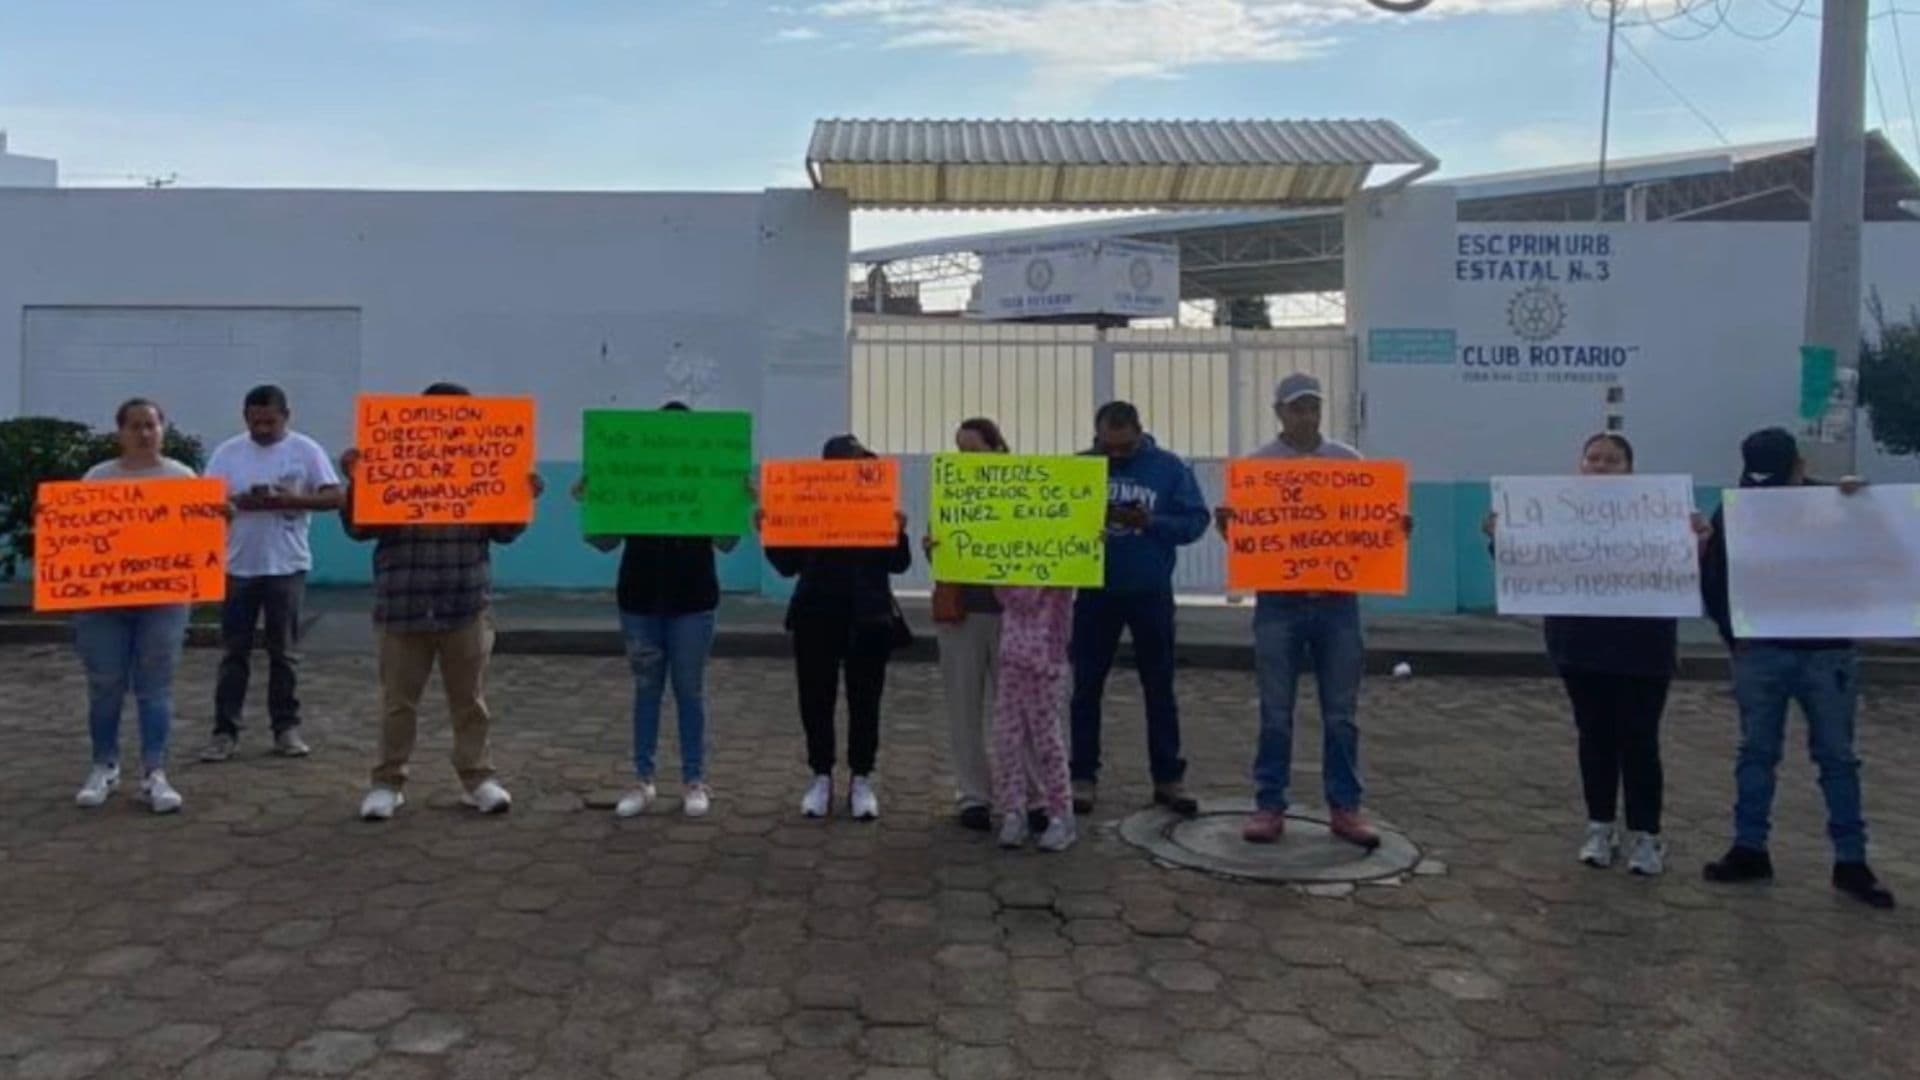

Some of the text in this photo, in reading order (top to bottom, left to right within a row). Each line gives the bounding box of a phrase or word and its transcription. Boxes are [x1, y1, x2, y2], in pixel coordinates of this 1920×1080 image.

[1456, 259, 1561, 281] ESTATAL
[1595, 259, 1611, 281] 3
[366, 403, 390, 427] LA
[372, 424, 524, 443] DIRECTIVA VIOLA
[364, 441, 517, 463] EL REGLAMENTO
[366, 460, 500, 485] ESCOLAR DE
[935, 457, 967, 485] ¡EL
[1263, 469, 1376, 489] SEGURIDAD
[44, 485, 145, 507] JUSTICIA
[382, 478, 506, 506] GUANAJUATO
[942, 484, 1032, 502] SUPERIOR
[1039, 485, 1064, 501] DE
[1069, 485, 1093, 500] LA
[1281, 487, 1304, 502] DE
[44, 503, 169, 532] PREVENTIVA
[1013, 502, 1072, 520] EXIGE
[1233, 501, 1402, 527] NUESTROS HIJOS
[1503, 490, 1544, 529] La
[1234, 528, 1396, 555] NO ES NEGOCIABLE
[79, 560, 115, 579] LEY
[120, 552, 195, 576] PROTEGE
[205, 549, 219, 569] A
[50, 581, 92, 599] LOS
